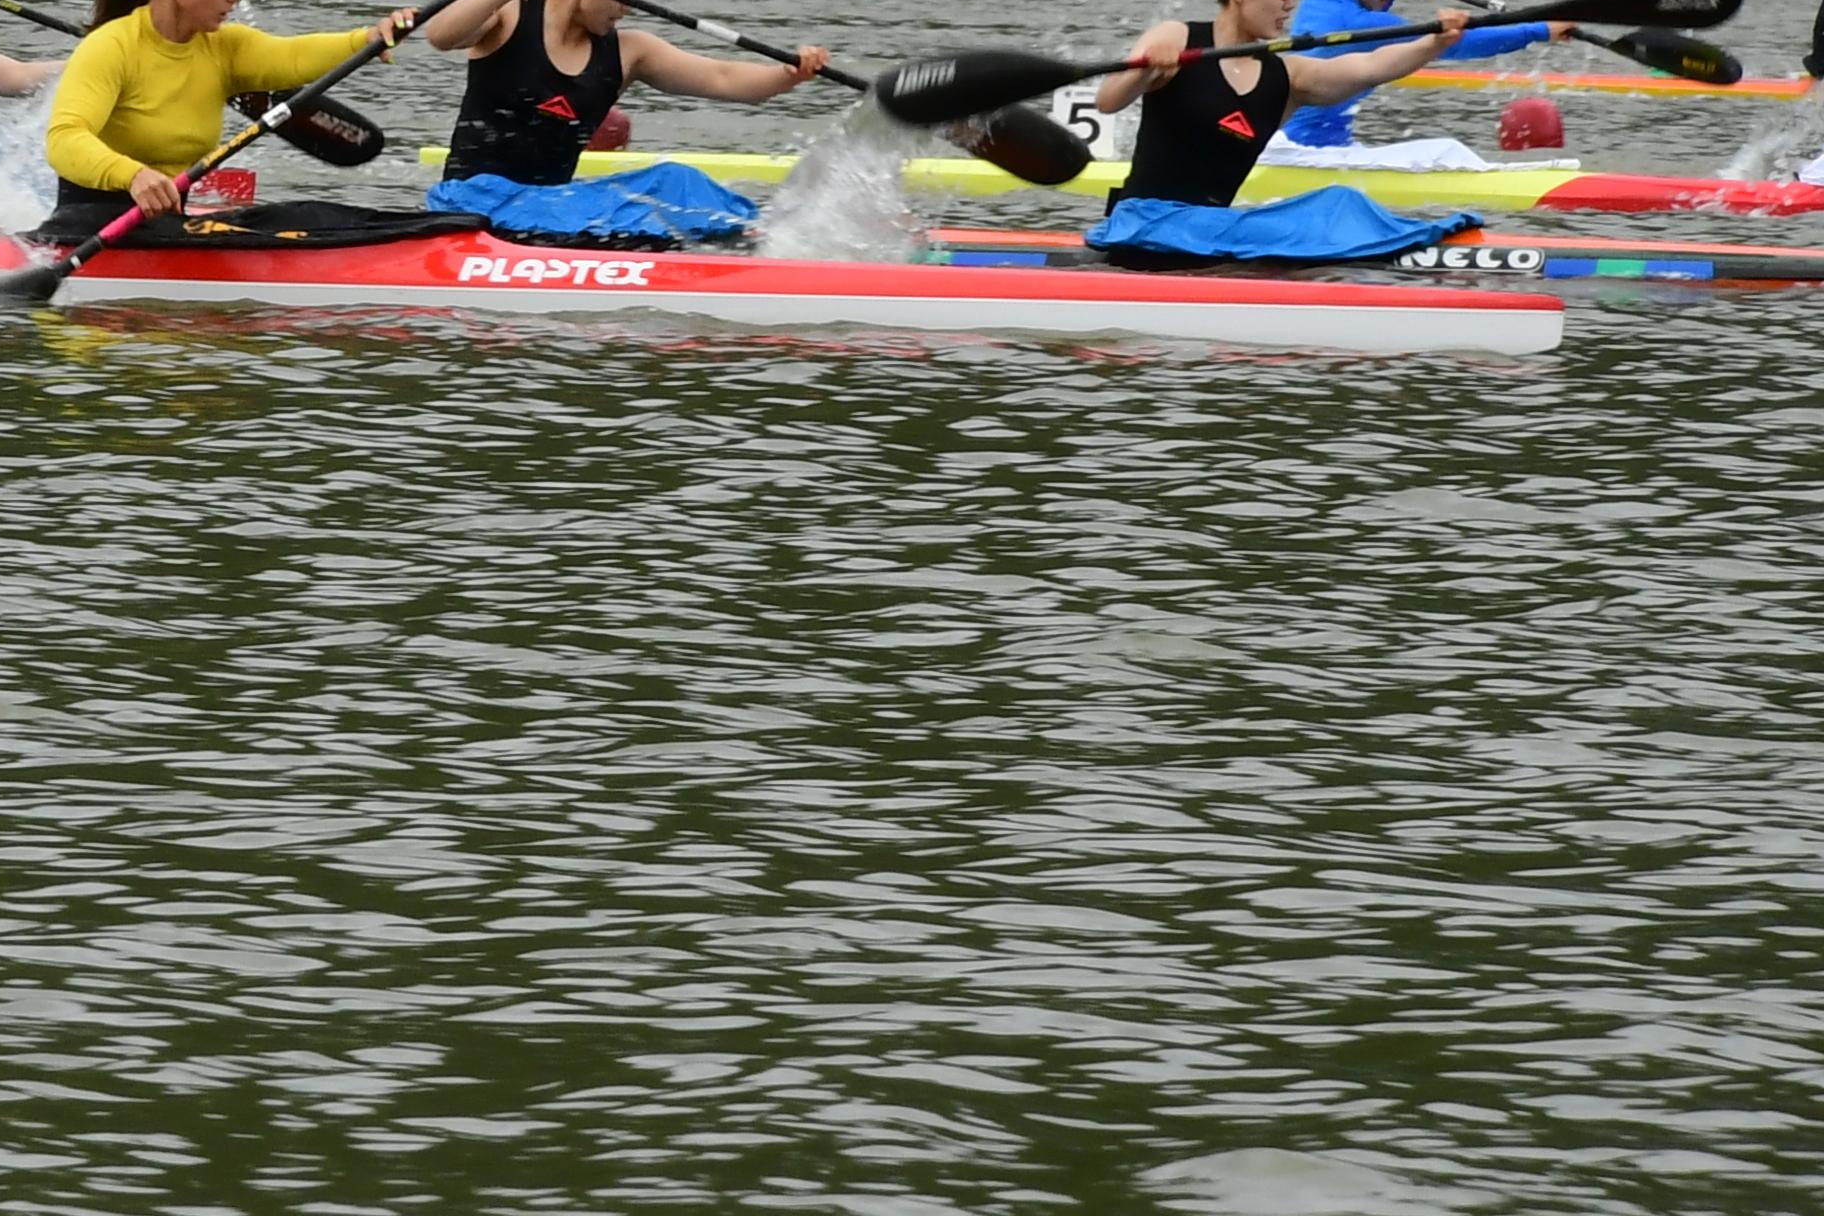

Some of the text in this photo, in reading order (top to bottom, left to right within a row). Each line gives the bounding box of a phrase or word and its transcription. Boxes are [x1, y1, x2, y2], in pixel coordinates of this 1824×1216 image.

[1068, 103, 1100, 145] 5
[458, 256, 655, 286] PLASTEX
[1399, 246, 1540, 269] NELO
